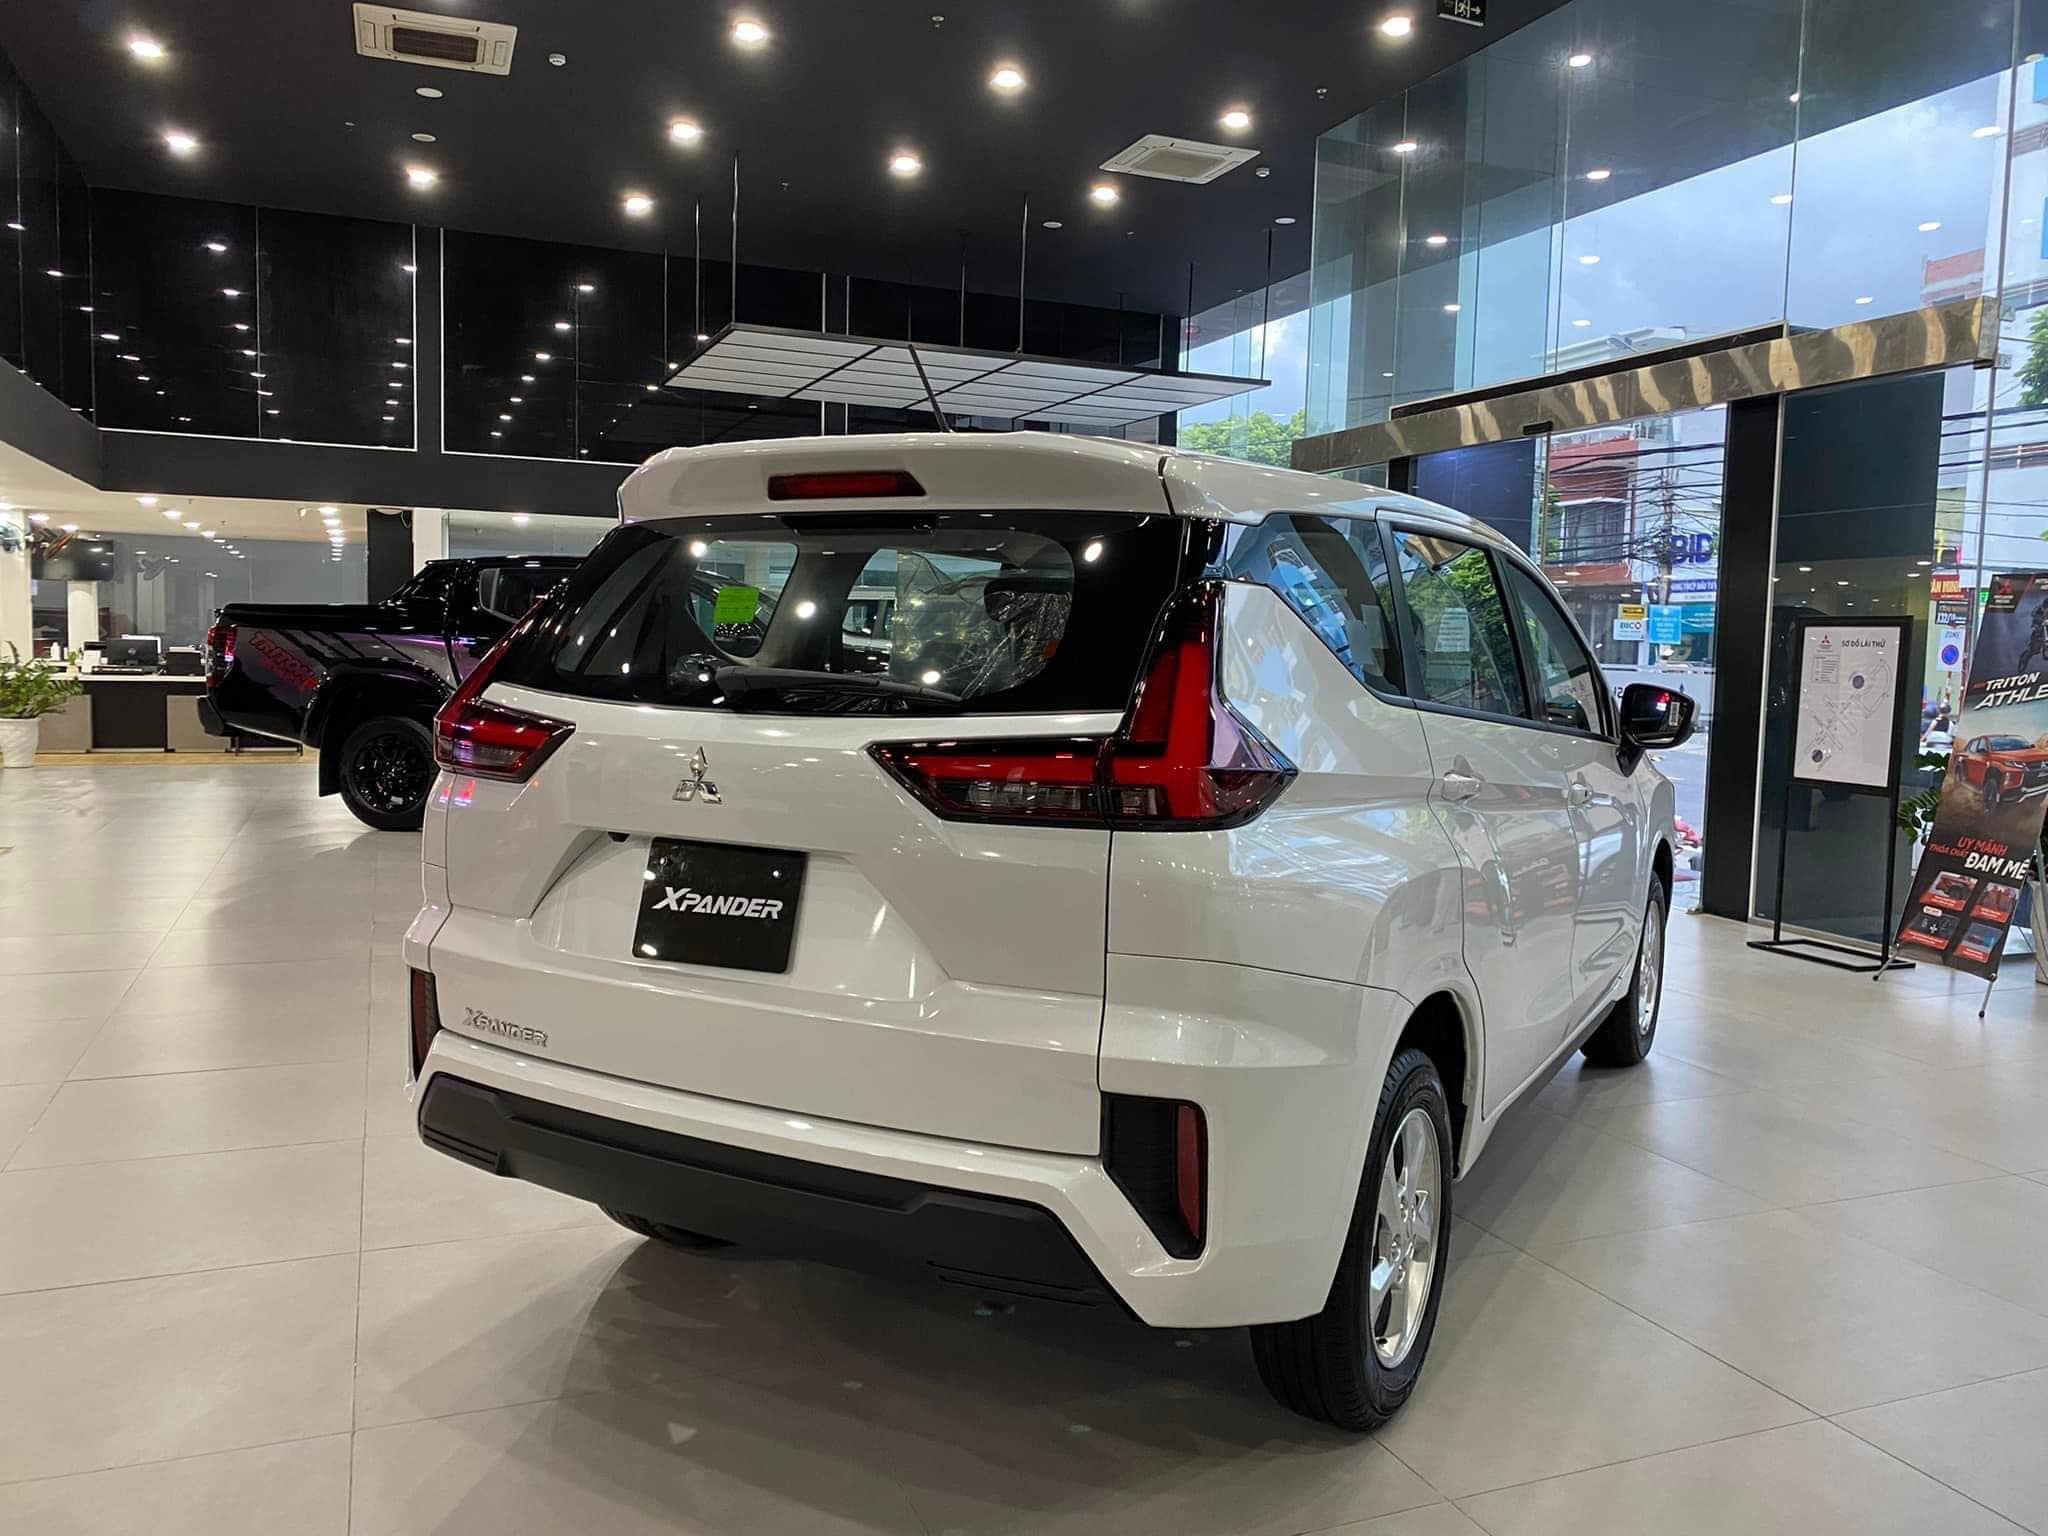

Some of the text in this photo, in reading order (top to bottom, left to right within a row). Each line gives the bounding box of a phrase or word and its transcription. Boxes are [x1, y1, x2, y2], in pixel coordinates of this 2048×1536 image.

[1985, 671, 2040, 692] TRITON
[1957, 836, 2009, 857] UY MÃNH
[1964, 852, 2005, 875] ĐAM
[2001, 858, 2030, 880] MÊ
[651, 886, 784, 920] XPANDER
[462, 1007, 548, 1047] XPANDER
